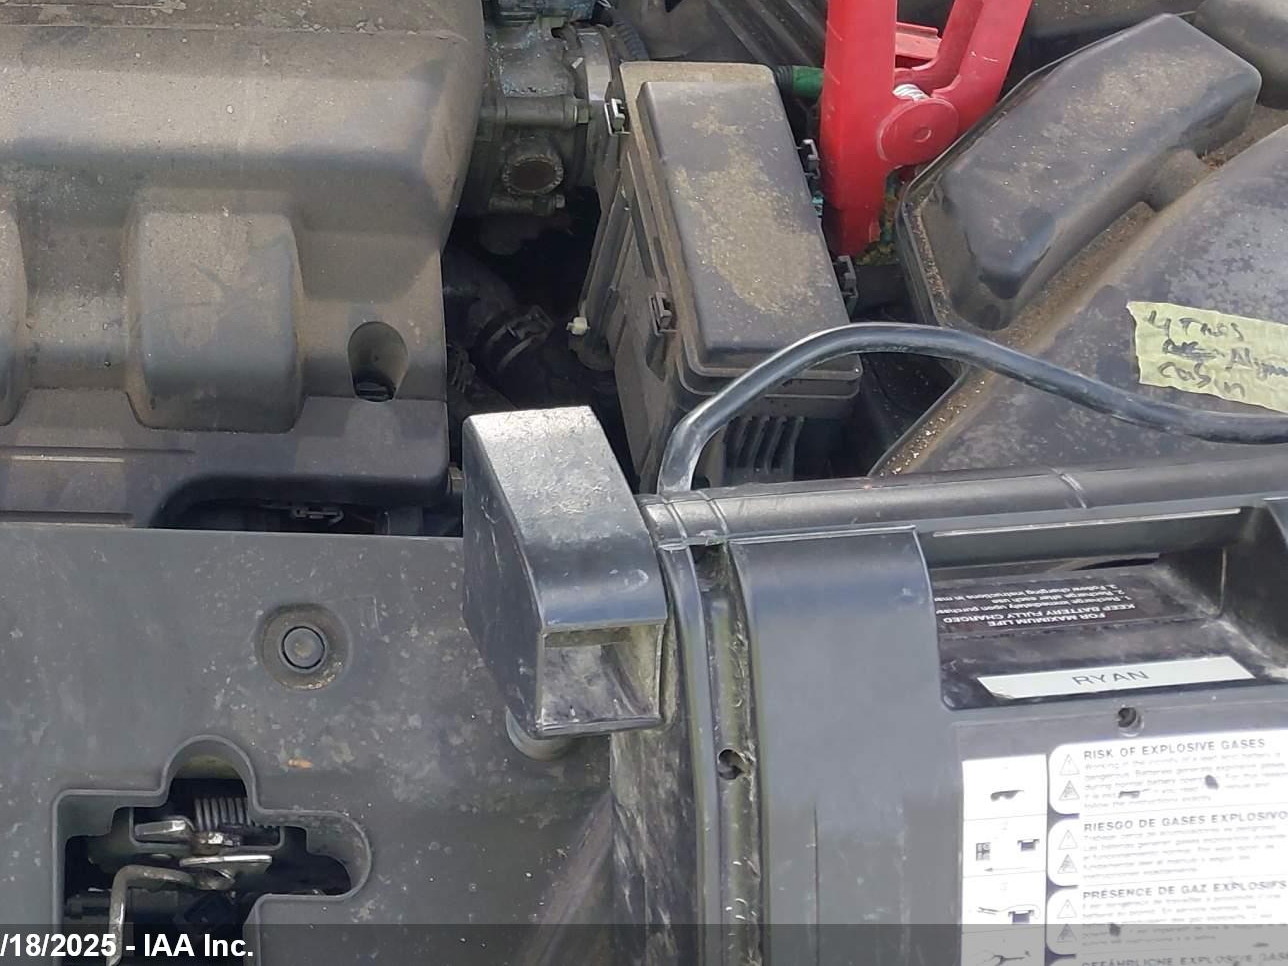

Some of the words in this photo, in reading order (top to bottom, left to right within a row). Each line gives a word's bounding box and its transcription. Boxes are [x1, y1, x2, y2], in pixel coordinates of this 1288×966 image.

[1007, 610, 1043, 619] FULLY
[1045, 605, 1100, 616] BATTERY
[943, 614, 1005, 624] CHARGED
[1016, 613, 1078, 625] MAXIMUM
[1071, 670, 1150, 686] RYAN
[1083, 748, 1113, 760] RISK
[1119, 746, 1136, 757] OF
[1142, 740, 1215, 756] EXPLOSIVE
[1220, 738, 1266, 750] GASES
[1083, 819, 1133, 832] RIESGO
[1138, 817, 1156, 828] DE
[1161, 814, 1206, 827] GASES
[1157, 885, 1176, 895] DE
[1180, 883, 1207, 894] GAZ
